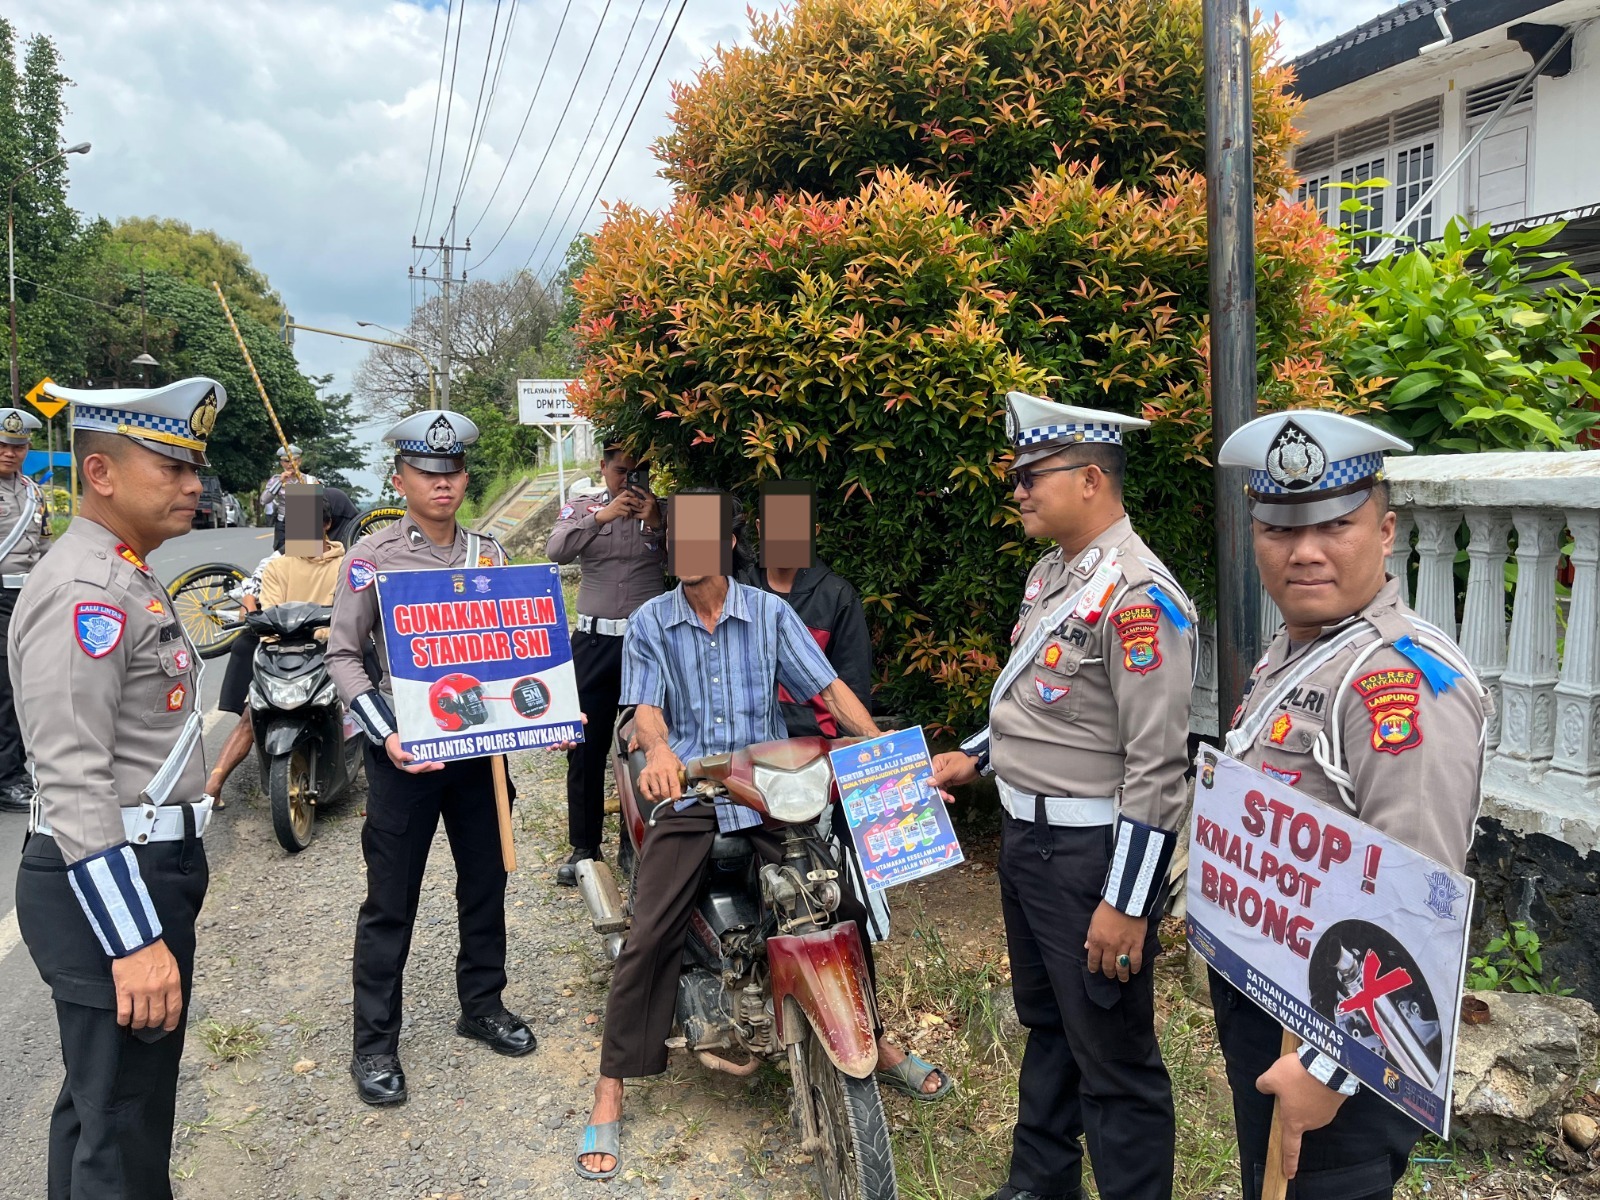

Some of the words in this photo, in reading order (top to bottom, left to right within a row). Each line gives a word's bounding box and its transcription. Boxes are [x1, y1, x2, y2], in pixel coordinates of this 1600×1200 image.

[536, 399, 554, 409] DPM
[394, 600, 499, 635] GUNAKAN
[500, 597, 556, 628] HELM
[1120, 608, 1151, 618] POLRES
[1122, 626, 1155, 635] LAMPUNG
[411, 632, 512, 668] STANDAR
[512, 628, 551, 659] SNI
[522, 688, 542, 700] SNI
[1361, 671, 1414, 687] POLRES
[1368, 693, 1415, 707] LAMPUNG
[411, 738, 475, 761] SATLANTAS
[476, 732, 516, 752] POLRES
[517, 725, 575, 746] WAYKANAN
[838, 770, 865, 784] TERTIB
[864, 760, 899, 775] BERLALU
[900, 751, 926, 765] LINTAS
[1241, 789, 1352, 873] STOP
[875, 857, 906, 872] UTAMAKAN
[906, 844, 946, 862] KESELAMATAN
[900, 861, 919, 872] JALAN
[1195, 814, 1321, 909] KNALPOT
[1201, 860, 1315, 960] BRONG
[1246, 969, 1282, 1002] SATUAN
[1283, 995, 1307, 1019] LALU
[1308, 1014, 1344, 1046] LINTAS
[1246, 982, 1278, 1013] POLRES
[1279, 1006, 1302, 1031] WAY
[1303, 1025, 1341, 1060] KANAN
